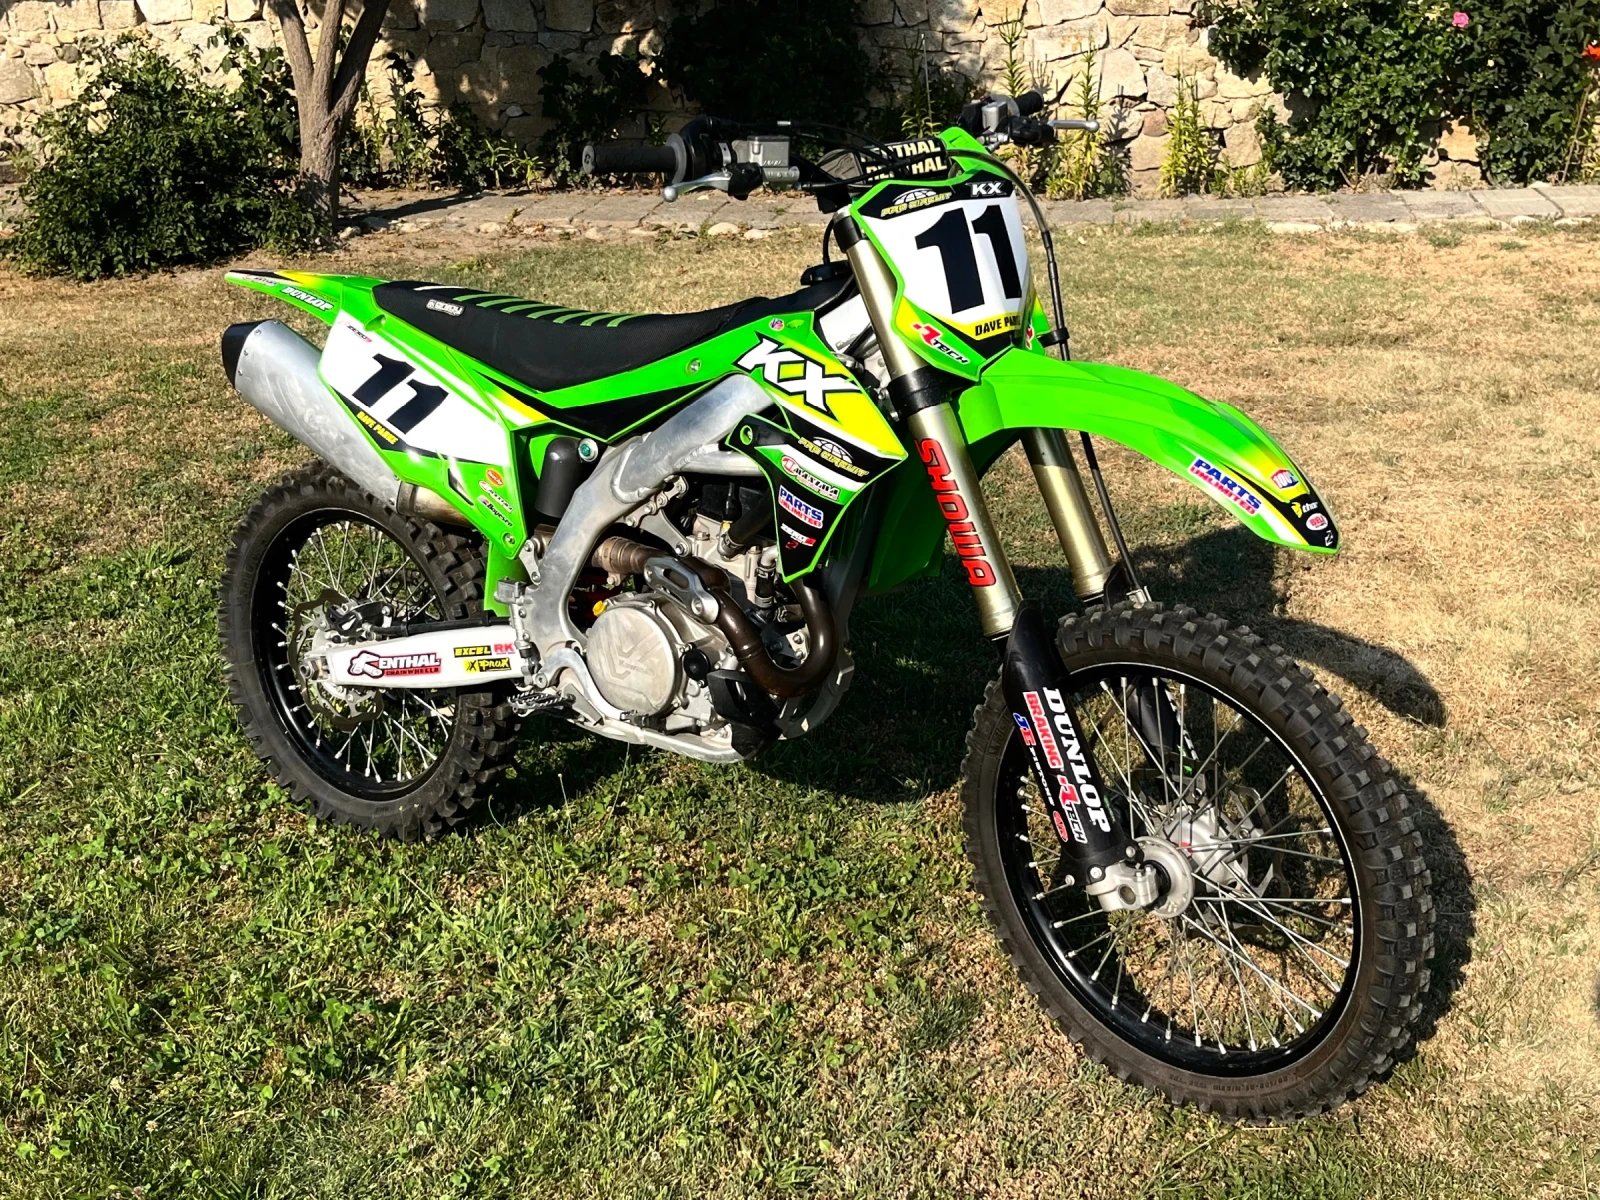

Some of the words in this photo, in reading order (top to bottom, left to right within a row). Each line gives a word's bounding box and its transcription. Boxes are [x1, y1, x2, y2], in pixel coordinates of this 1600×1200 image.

[861, 139, 942, 163] THAL
[865, 156, 948, 182] REHAL
[881, 203, 907, 217] PRO
[908, 192, 952, 210] CIRCUIT
[965, 181, 1007, 198] KX
[914, 203, 1023, 315] 11
[280, 286, 334, 312] DUNLOP
[974, 318, 1002, 337] DAVE
[351, 352, 450, 435] 11
[734, 332, 864, 417] KX
[356, 410, 377, 429] DAVE
[797, 436, 822, 455] PRO
[820, 450, 870, 477] CIRCUIT
[1189, 465, 1256, 516] UNLIMITED
[1193, 458, 1262, 509] PARTS
[779, 486, 823, 521] PARTS
[914, 438, 997, 587] SHOWA
[454, 647, 492, 657] EXCEL
[493, 643, 515, 654] RK
[1022, 691, 1065, 770] BRAKING
[1013, 712, 1036, 746] JE
[1029, 746, 1056, 807] PISTONS
[1043, 686, 1112, 833] DUNLOP
